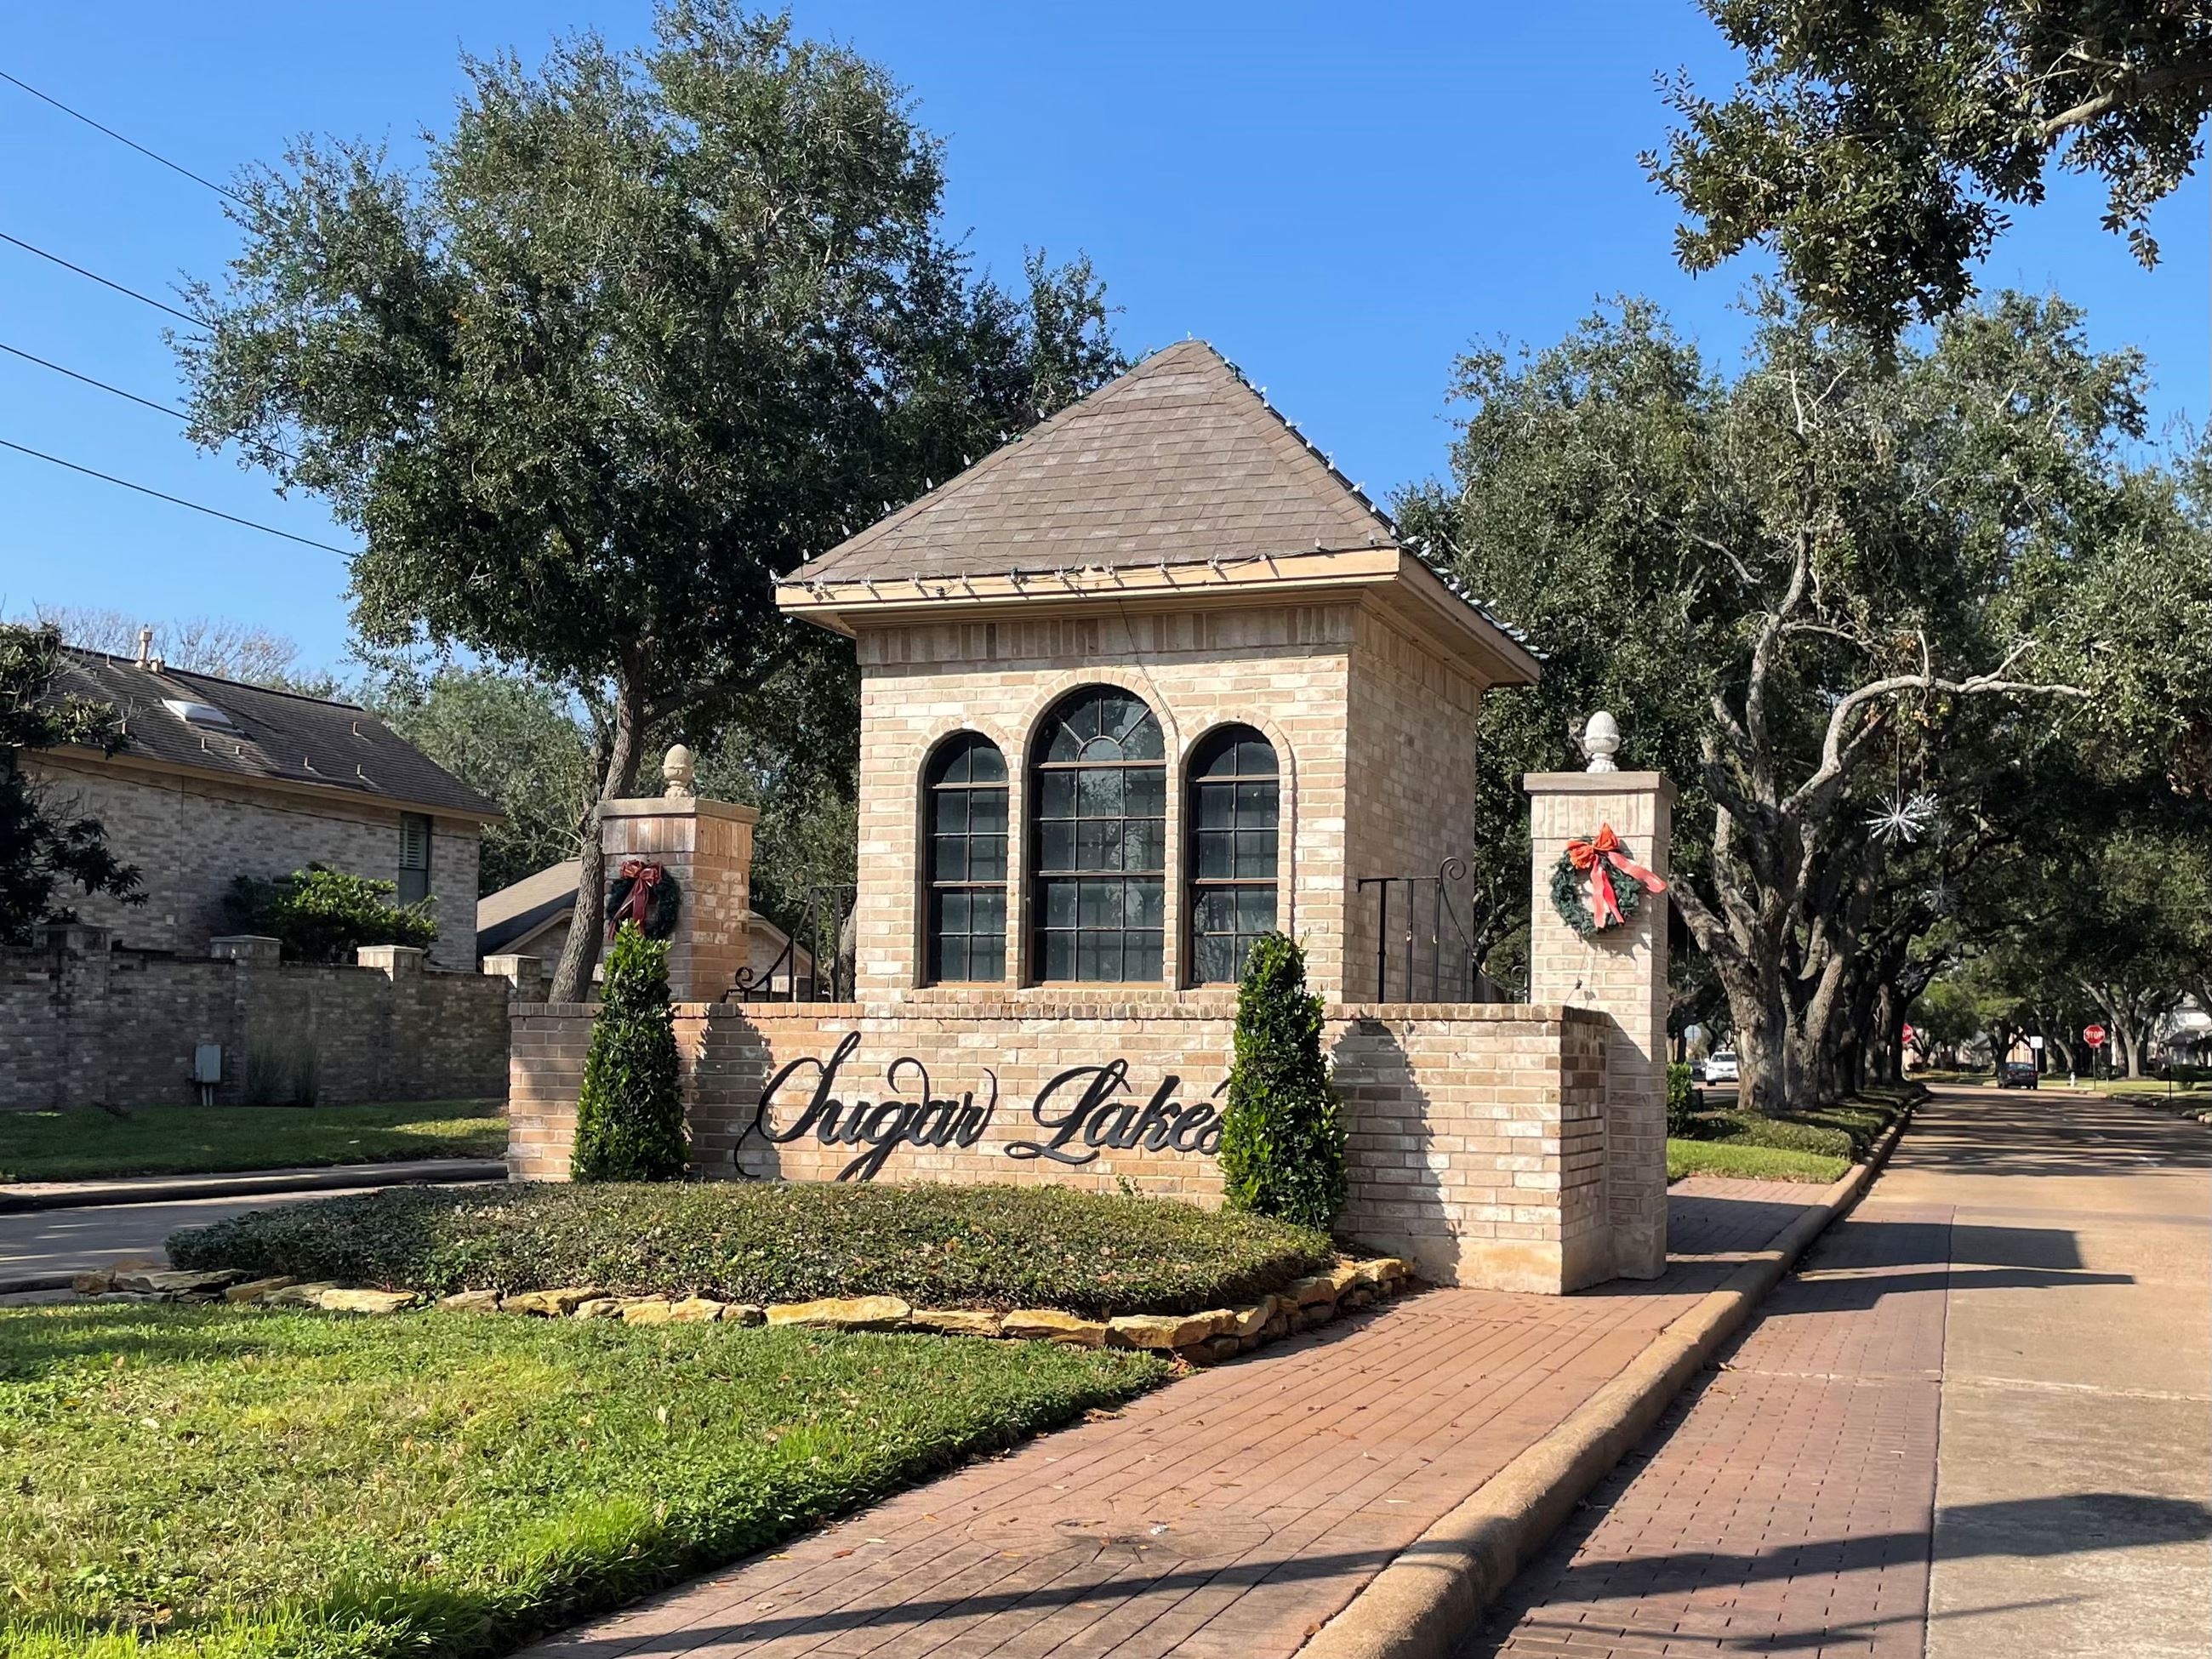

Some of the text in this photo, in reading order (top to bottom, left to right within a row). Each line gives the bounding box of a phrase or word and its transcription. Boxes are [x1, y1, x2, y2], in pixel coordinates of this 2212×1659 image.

[2084, 1031, 2104, 1040] STOP
[734, 1030, 1232, 1183] Sugar Lakes
